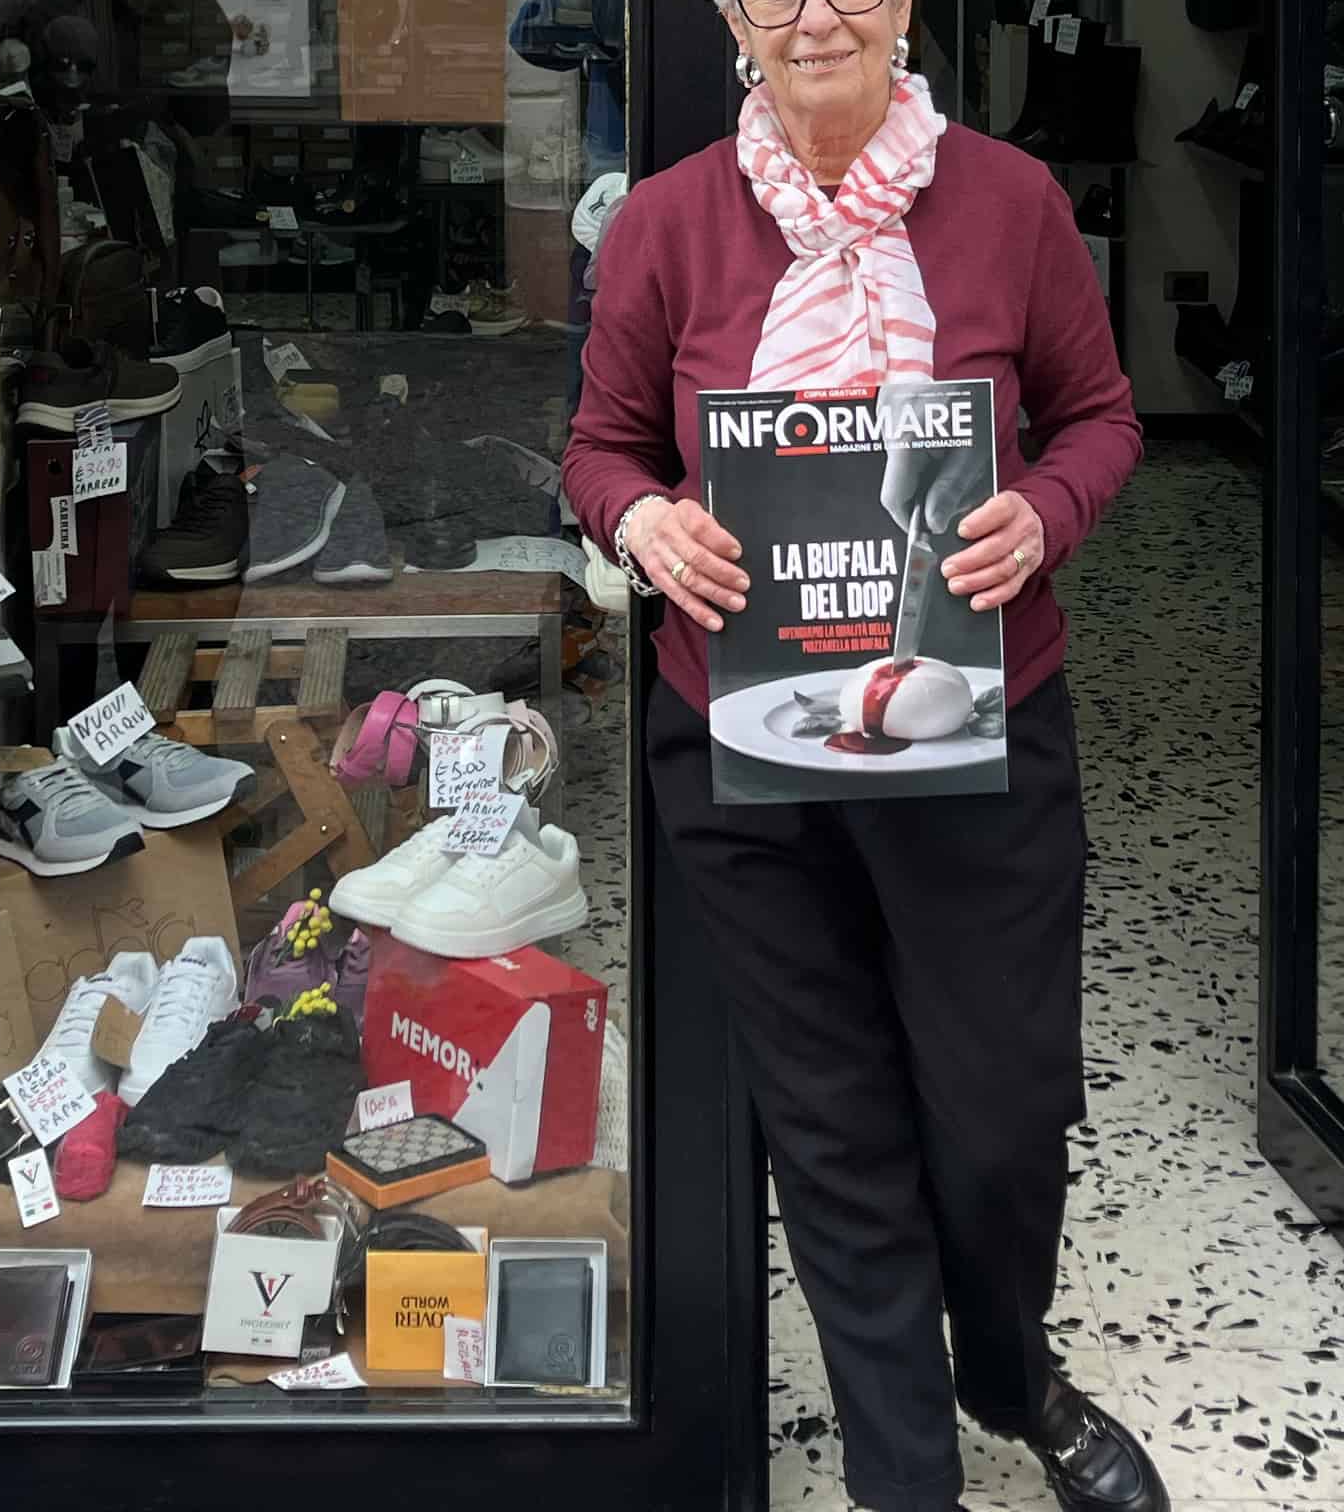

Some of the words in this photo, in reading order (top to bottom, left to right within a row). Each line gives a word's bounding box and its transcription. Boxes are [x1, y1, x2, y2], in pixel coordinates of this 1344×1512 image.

[708, 402, 974, 448] INFORMARE
[59, 499, 69, 550] CARRERA
[772, 544, 804, 581] LA
[807, 539, 898, 579] BUFALA
[800, 582, 843, 620] DEL
[846, 581, 895, 618] DOP
[74, 693, 126, 739] NUOVI
[395, 1311, 455, 1329] OVERI
[400, 1296, 449, 1308] WORLD
